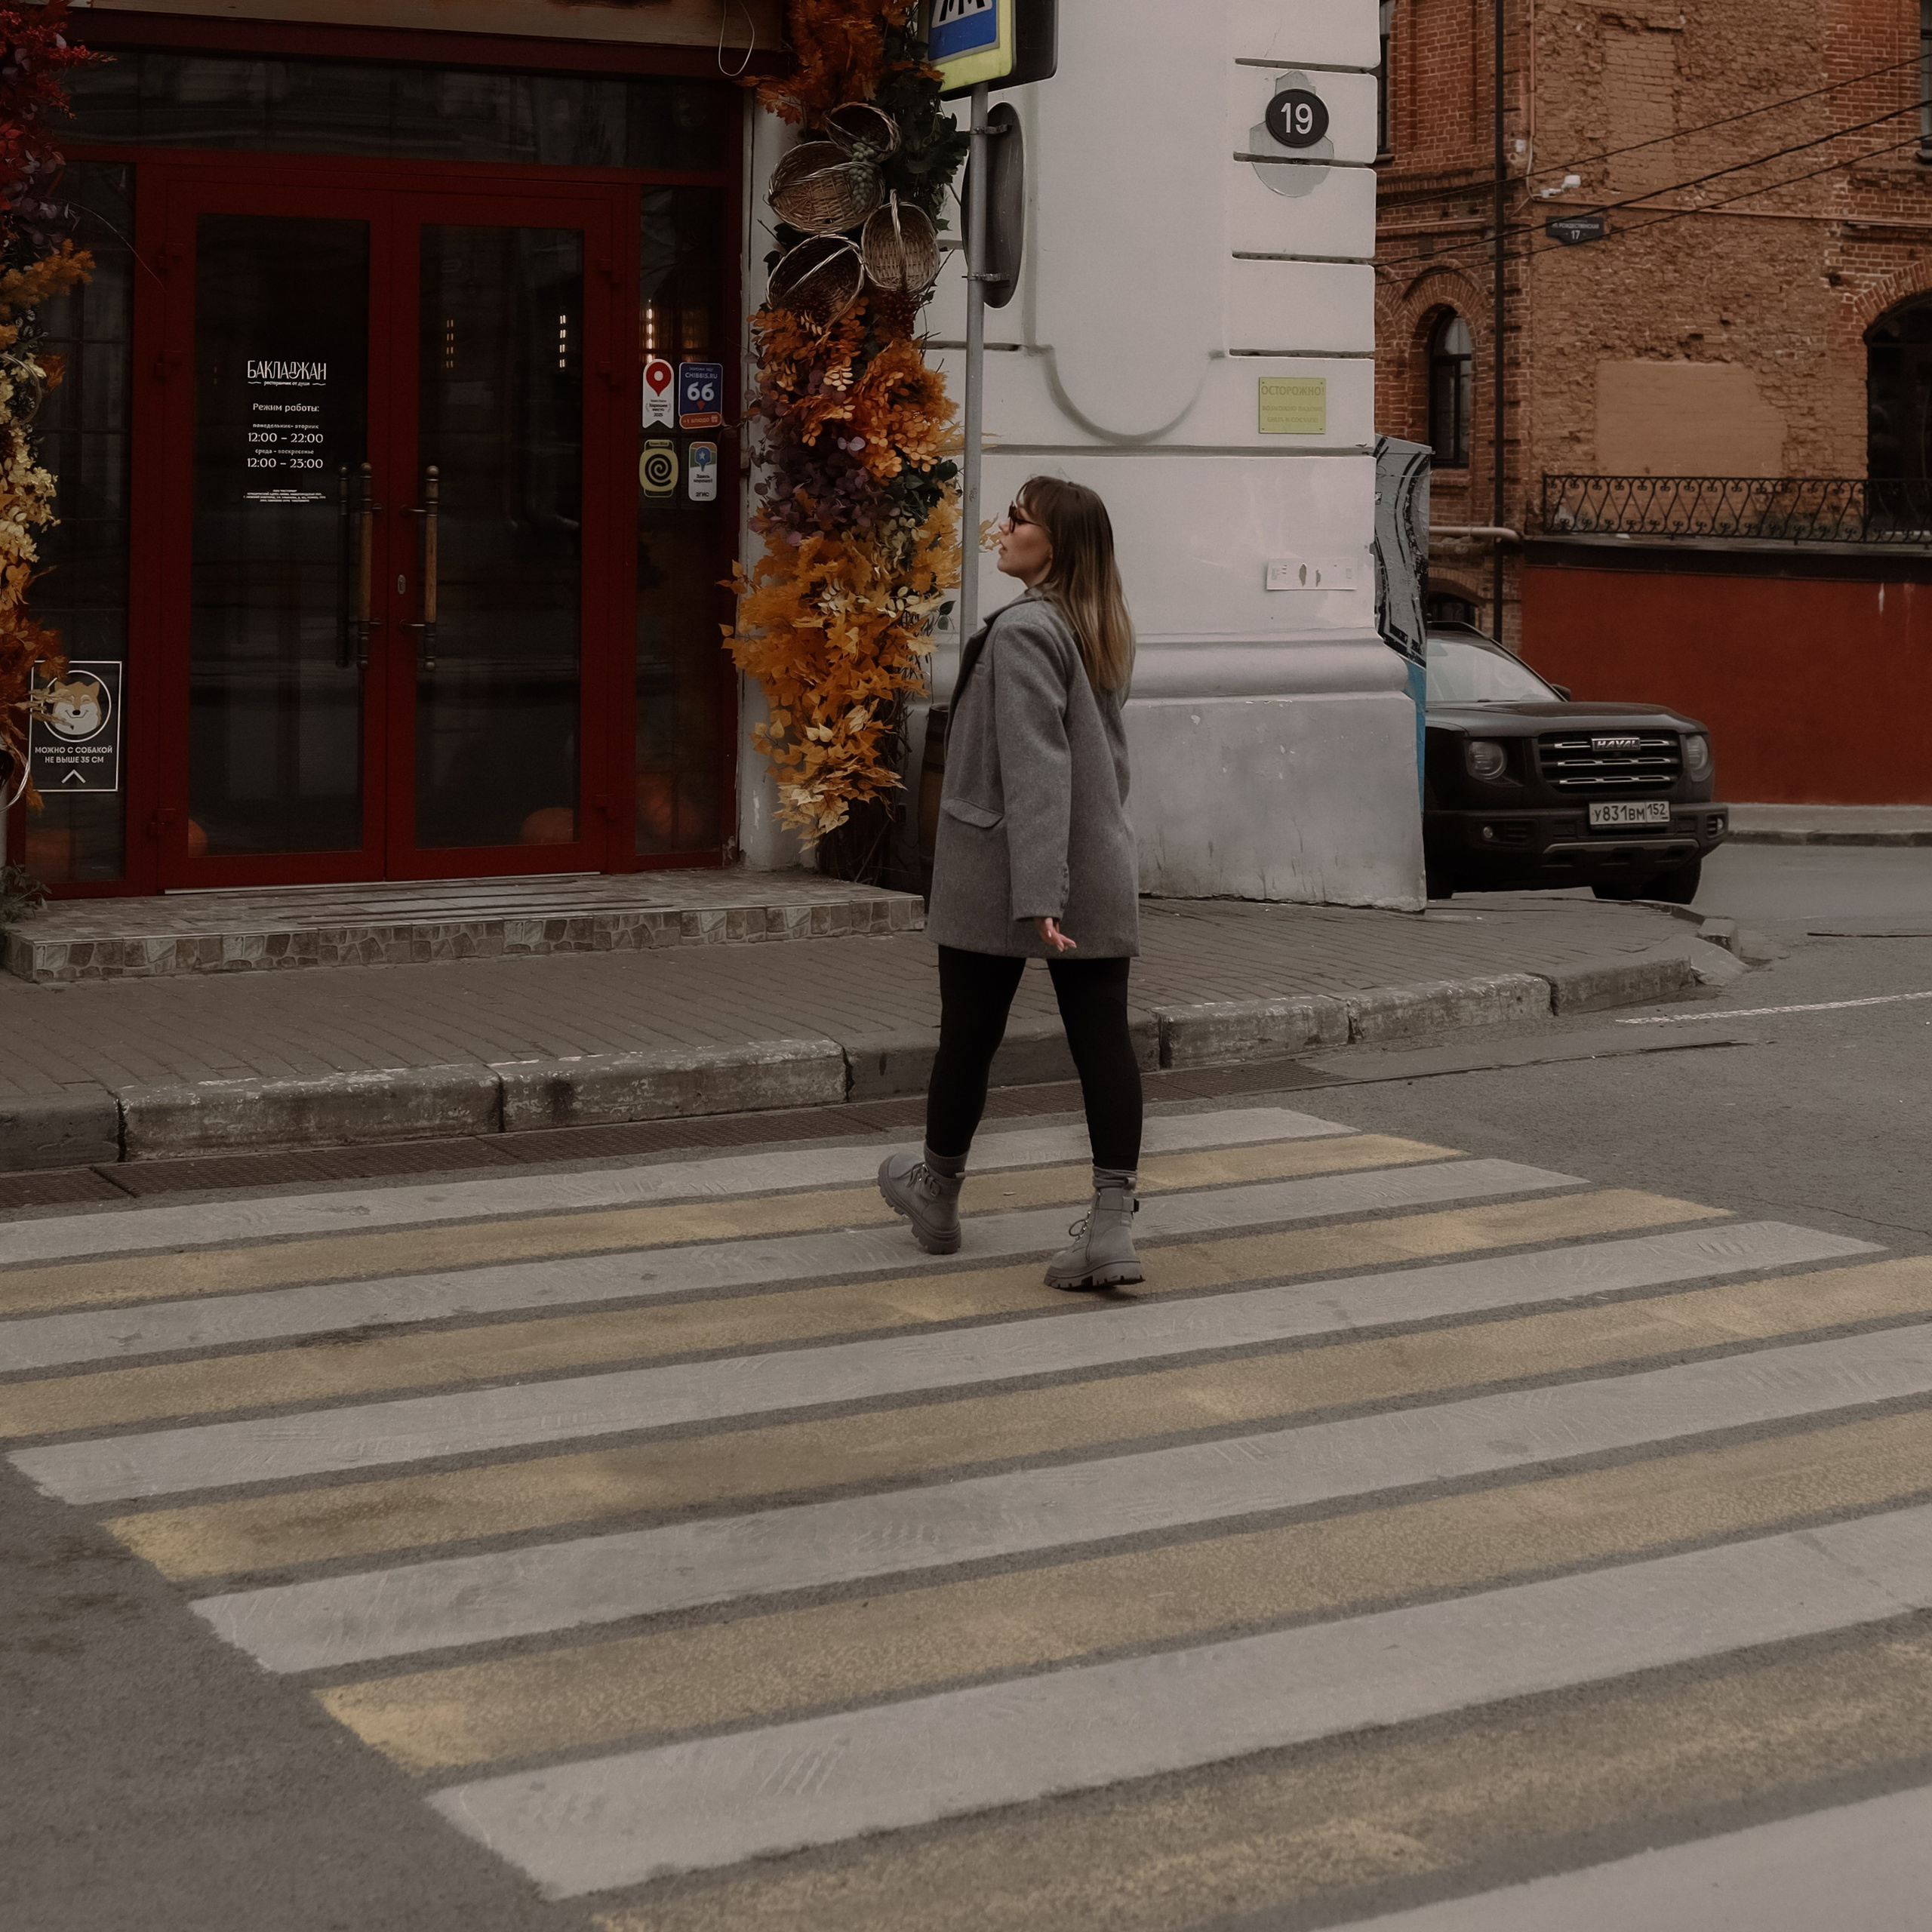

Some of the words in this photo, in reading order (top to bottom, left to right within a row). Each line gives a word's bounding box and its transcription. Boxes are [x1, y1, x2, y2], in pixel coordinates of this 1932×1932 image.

[1281, 103, 1313, 134] 19
[1571, 229, 1580, 239] 17
[1261, 386, 1324, 395] ОСТОРОЖНО!
[285, 403, 319, 412] работы:
[248, 432, 278, 442] 12:00
[291, 433, 324, 443] 22:00
[247, 457, 277, 467] 12:00
[290, 458, 323, 468] 23:00
[75, 745, 112, 754] СОБАКОЙ
[1597, 740, 1638, 749] HAVAL
[1594, 804, 1645, 822] У831ВМ
[1647, 803, 1666, 816] 152
